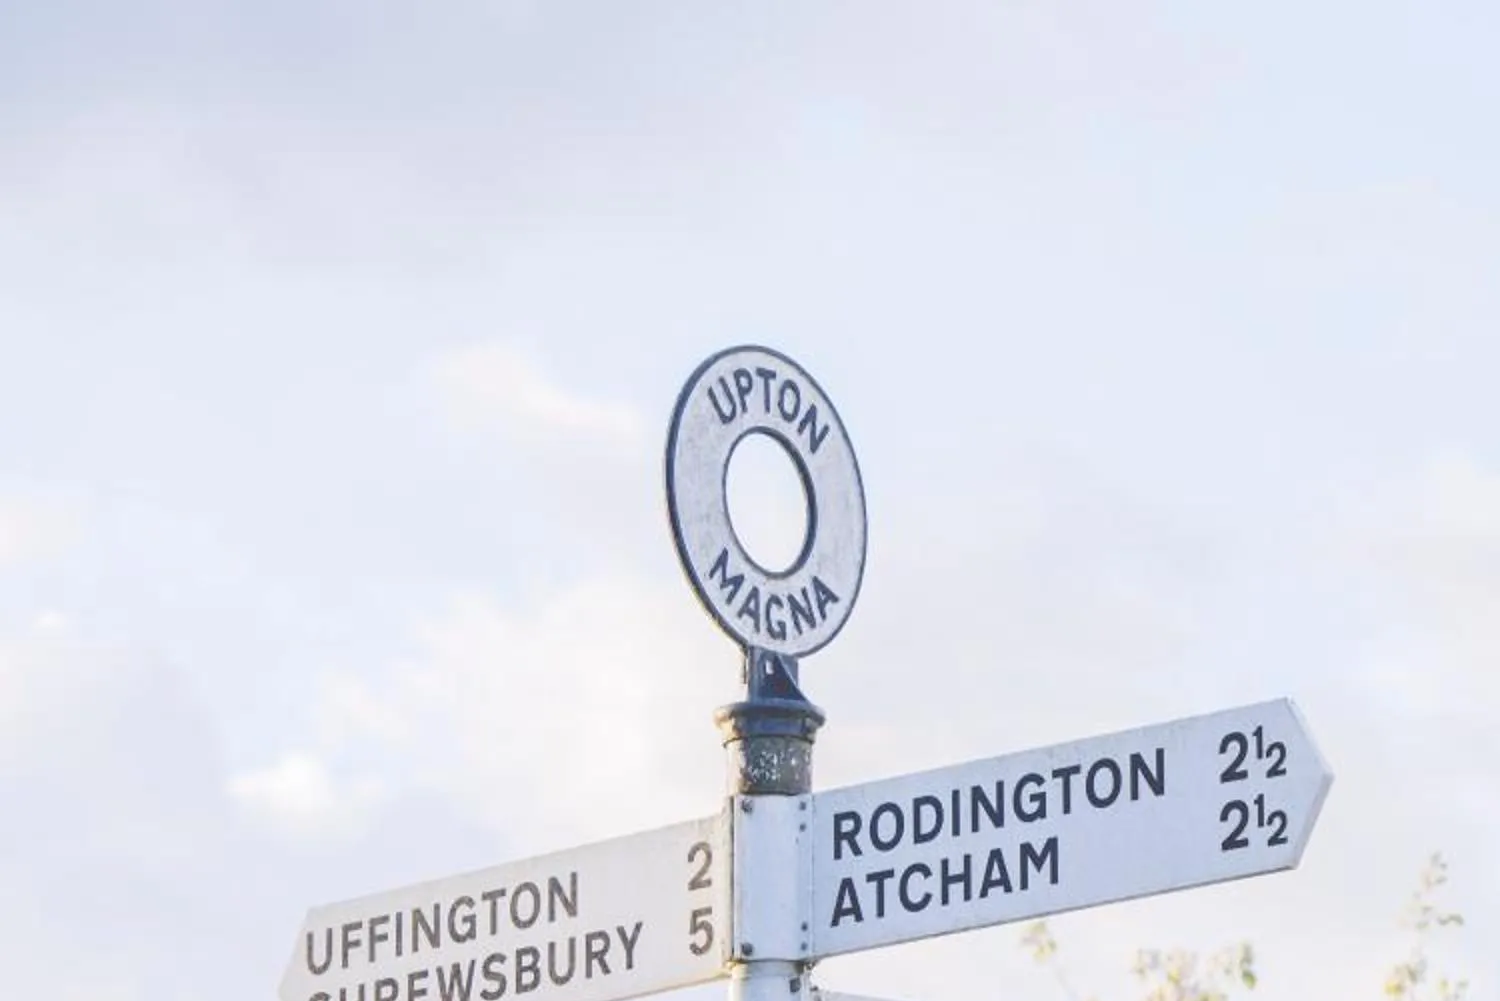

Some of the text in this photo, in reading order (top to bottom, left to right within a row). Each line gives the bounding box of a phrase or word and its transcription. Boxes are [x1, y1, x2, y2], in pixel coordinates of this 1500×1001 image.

[707, 366, 831, 456] UPTON
[708, 546, 841, 642] MAGNA
[832, 746, 1166, 861] RODINGTON
[306, 842, 713, 975] UFFINGTON 2
[830, 836, 1060, 928] ATCHAM
[688, 906, 714, 956] 5
